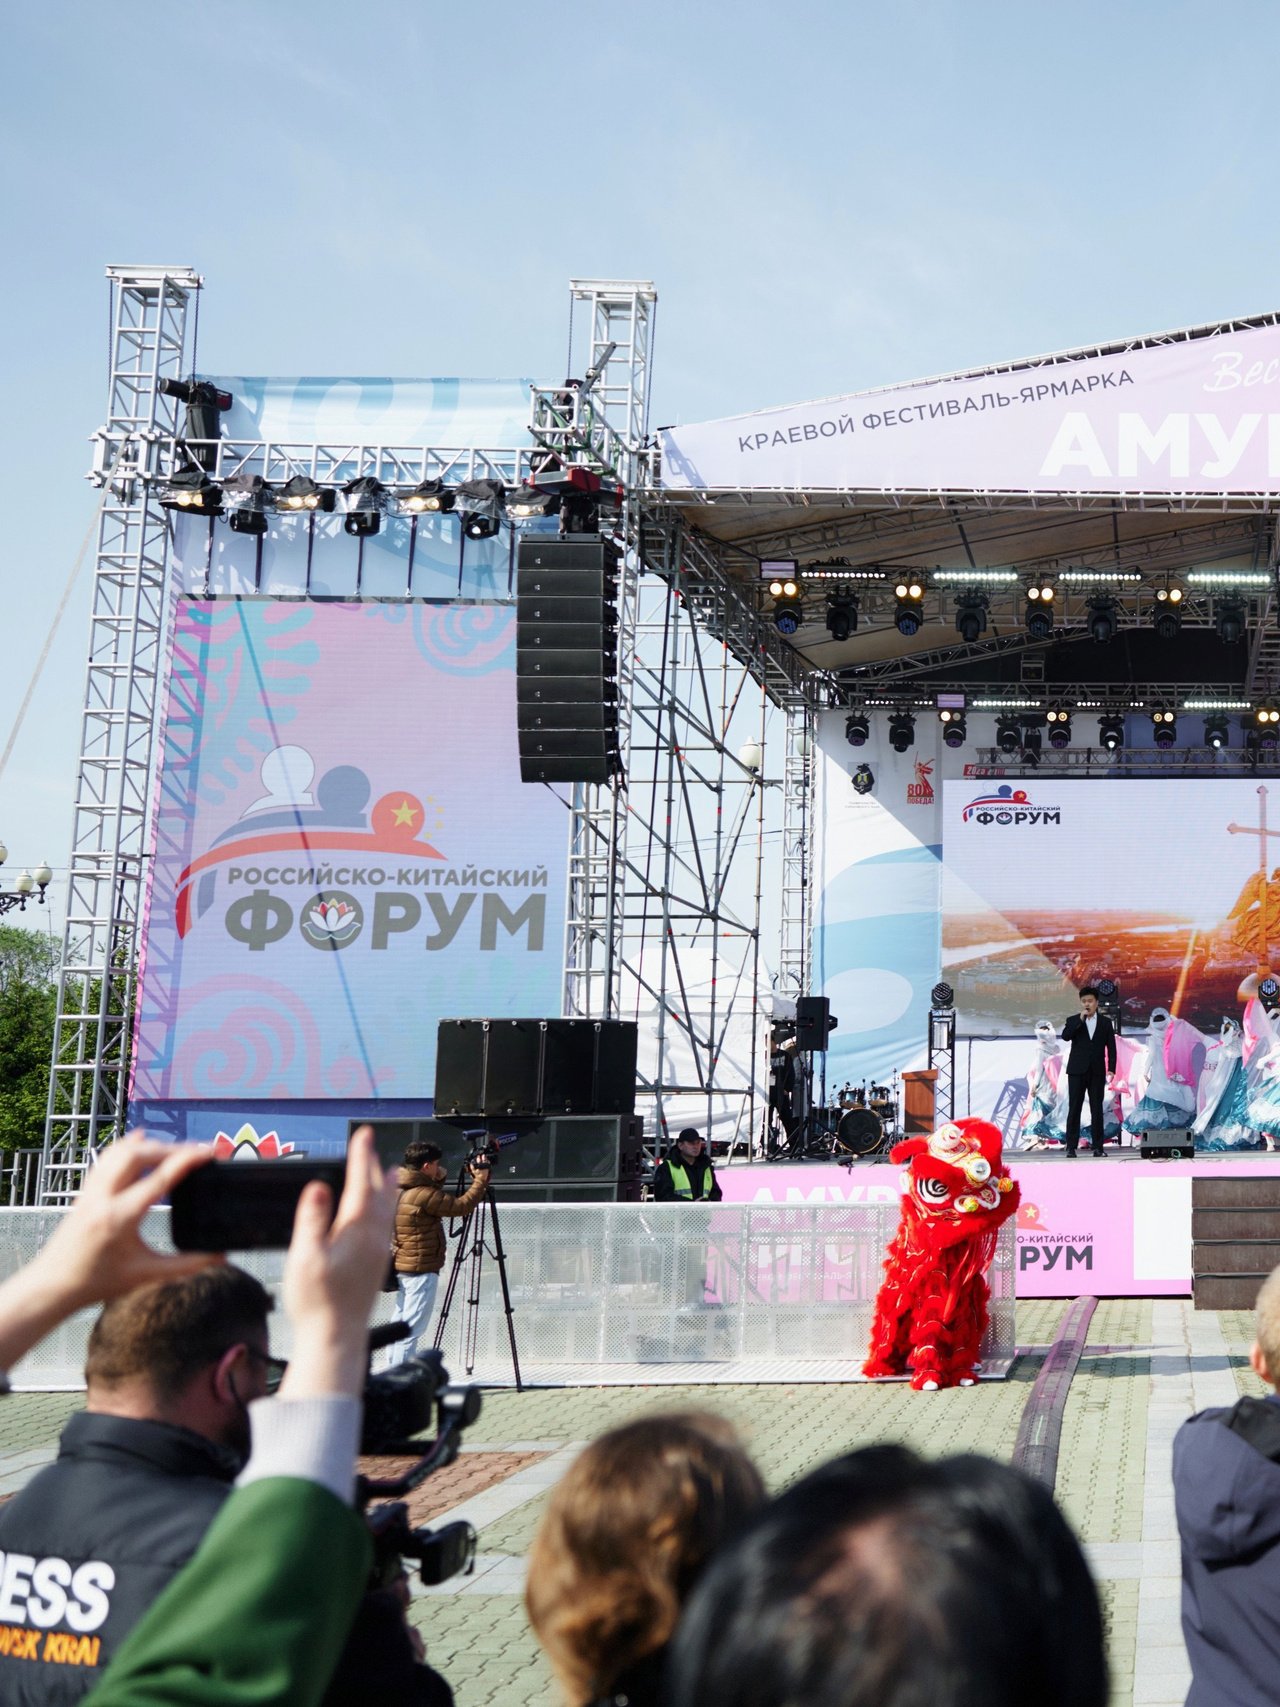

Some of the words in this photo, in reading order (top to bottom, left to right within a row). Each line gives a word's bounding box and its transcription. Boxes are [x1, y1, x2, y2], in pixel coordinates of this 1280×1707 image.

[738, 413, 855, 453] КРАЕВОЙ
[861, 369, 1135, 430] ФЕСТИВАЛЬ-ЯРМАРКА
[975, 804, 1061, 812] РОССИЙСКО-КИТАЙСКИЙ
[975, 811, 1061, 825] ФОРУМ
[227, 862, 549, 887] РОССИЙСКО-КИТАЙСКИЙ
[224, 888, 547, 952] ФОРУМ
[0, 1550, 116, 1633] ESS
[42, 1631, 101, 1668] KRAI
